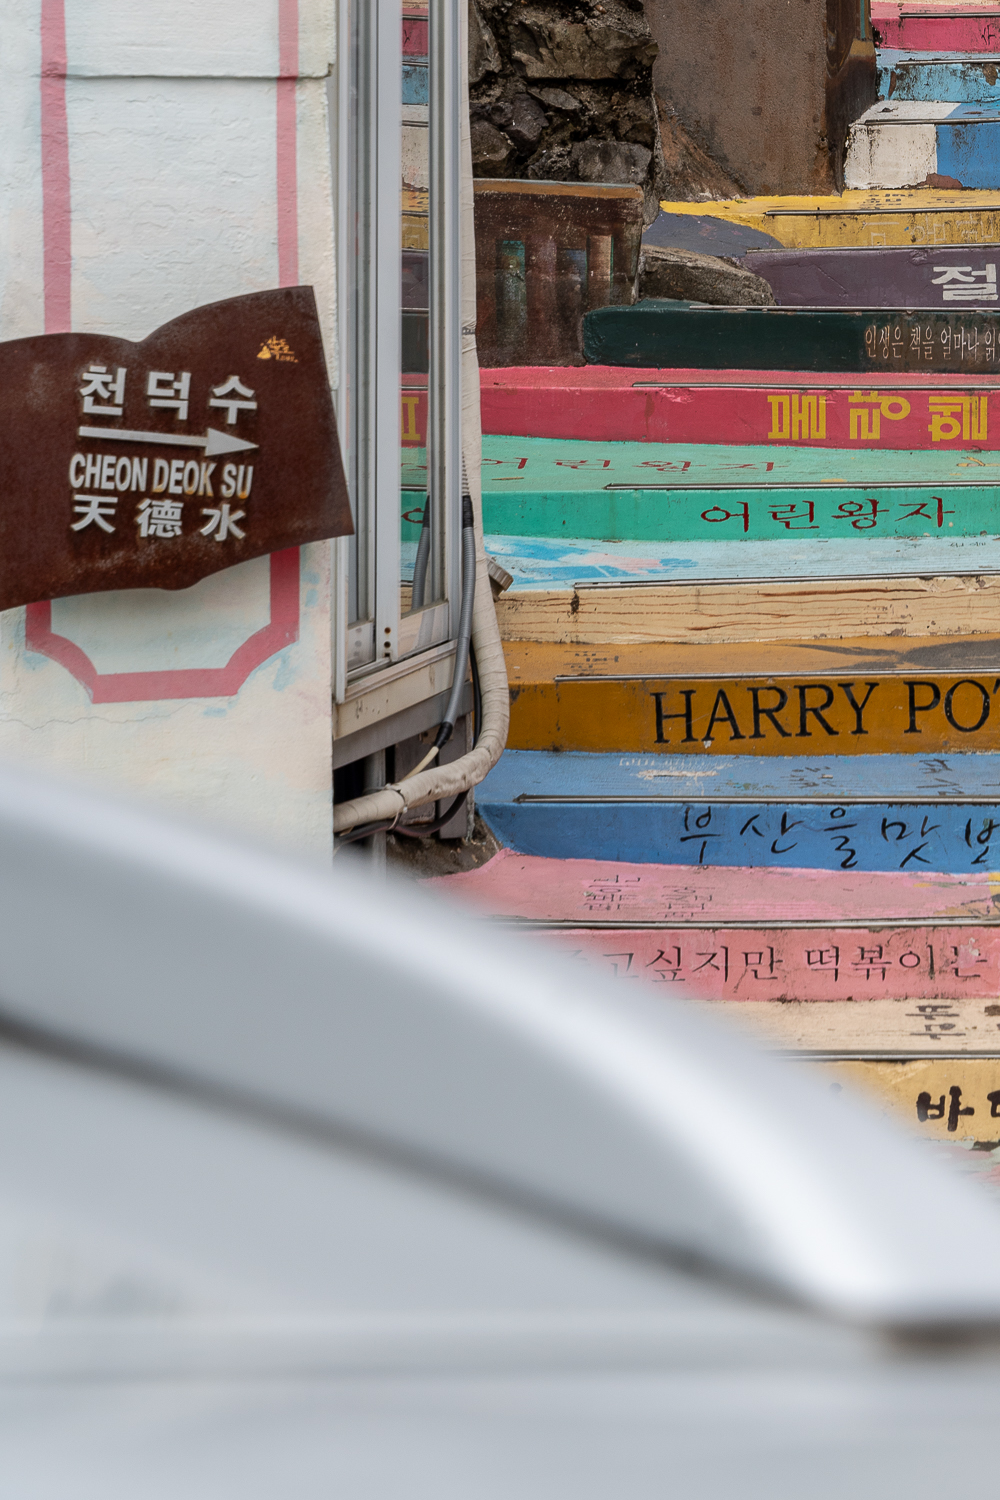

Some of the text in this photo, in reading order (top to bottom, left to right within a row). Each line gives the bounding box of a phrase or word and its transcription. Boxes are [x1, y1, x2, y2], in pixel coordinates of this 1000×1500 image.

[865, 324, 904, 360] 인생은
[909, 324, 935, 360] 책을
[940, 325, 980, 362] 얼마나
[79, 364, 258, 425] 천덕수
[69, 453, 254, 499] CHEON DEOK SU
[70, 494, 247, 542] 天德水
[700, 496, 956, 534] 어린왕자
[652, 681, 880, 745] HARRY
